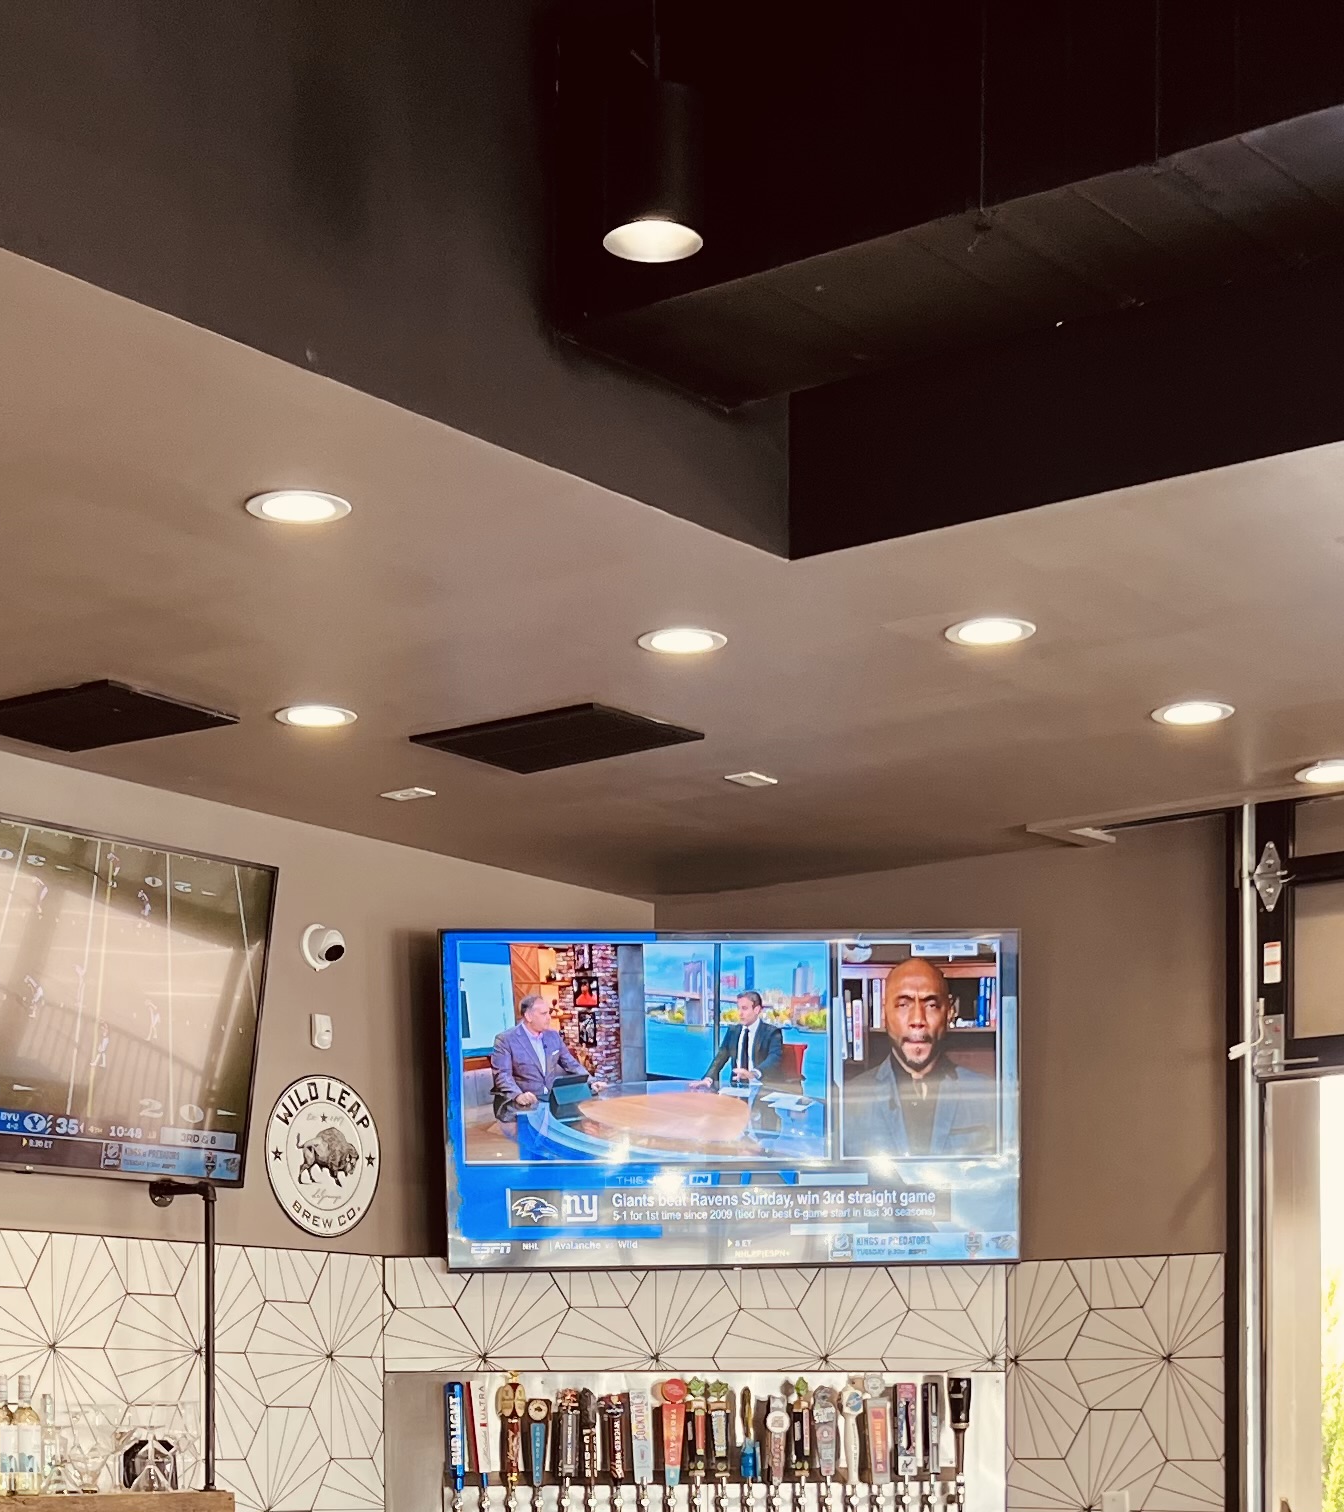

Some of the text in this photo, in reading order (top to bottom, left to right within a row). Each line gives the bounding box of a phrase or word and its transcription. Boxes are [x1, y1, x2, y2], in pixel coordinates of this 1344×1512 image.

[275, 1081, 370, 1130] WILD LEAP
[0, 1111, 20, 1122] BYU
[56, 1117, 79, 1135] 35
[616, 1175, 643, 1185] THIS
[691, 1175, 709, 1184] IN
[611, 1189, 936, 1209] Giants beat Ravens Sunday, win 3rd straight game
[292, 1199, 334, 1230] BREW
[612, 1210, 628, 1221] 5-1
[630, 1210, 643, 1221] for
[645, 1210, 659, 1221] 1st
[661, 1210, 681, 1220] time
[683, 1209, 707, 1220] since
[710, 1209, 733, 1220] 2009
[757, 1208, 770, 1219] for
[772, 1208, 792, 1219] best
[794, 1208, 828, 1221] 6-game
[830, 1207, 851, 1219] start
[881, 1206, 894, 1217] 30
[894, 1206, 936, 1218] seasons)
[470, 1242, 512, 1254] ESPN
[554, 1241, 602, 1250] Avalanche
[617, 1240, 638, 1249] Wild
[477, 1385, 488, 1421] ULTRA
[449, 1395, 462, 1466] BUD LIGHT
